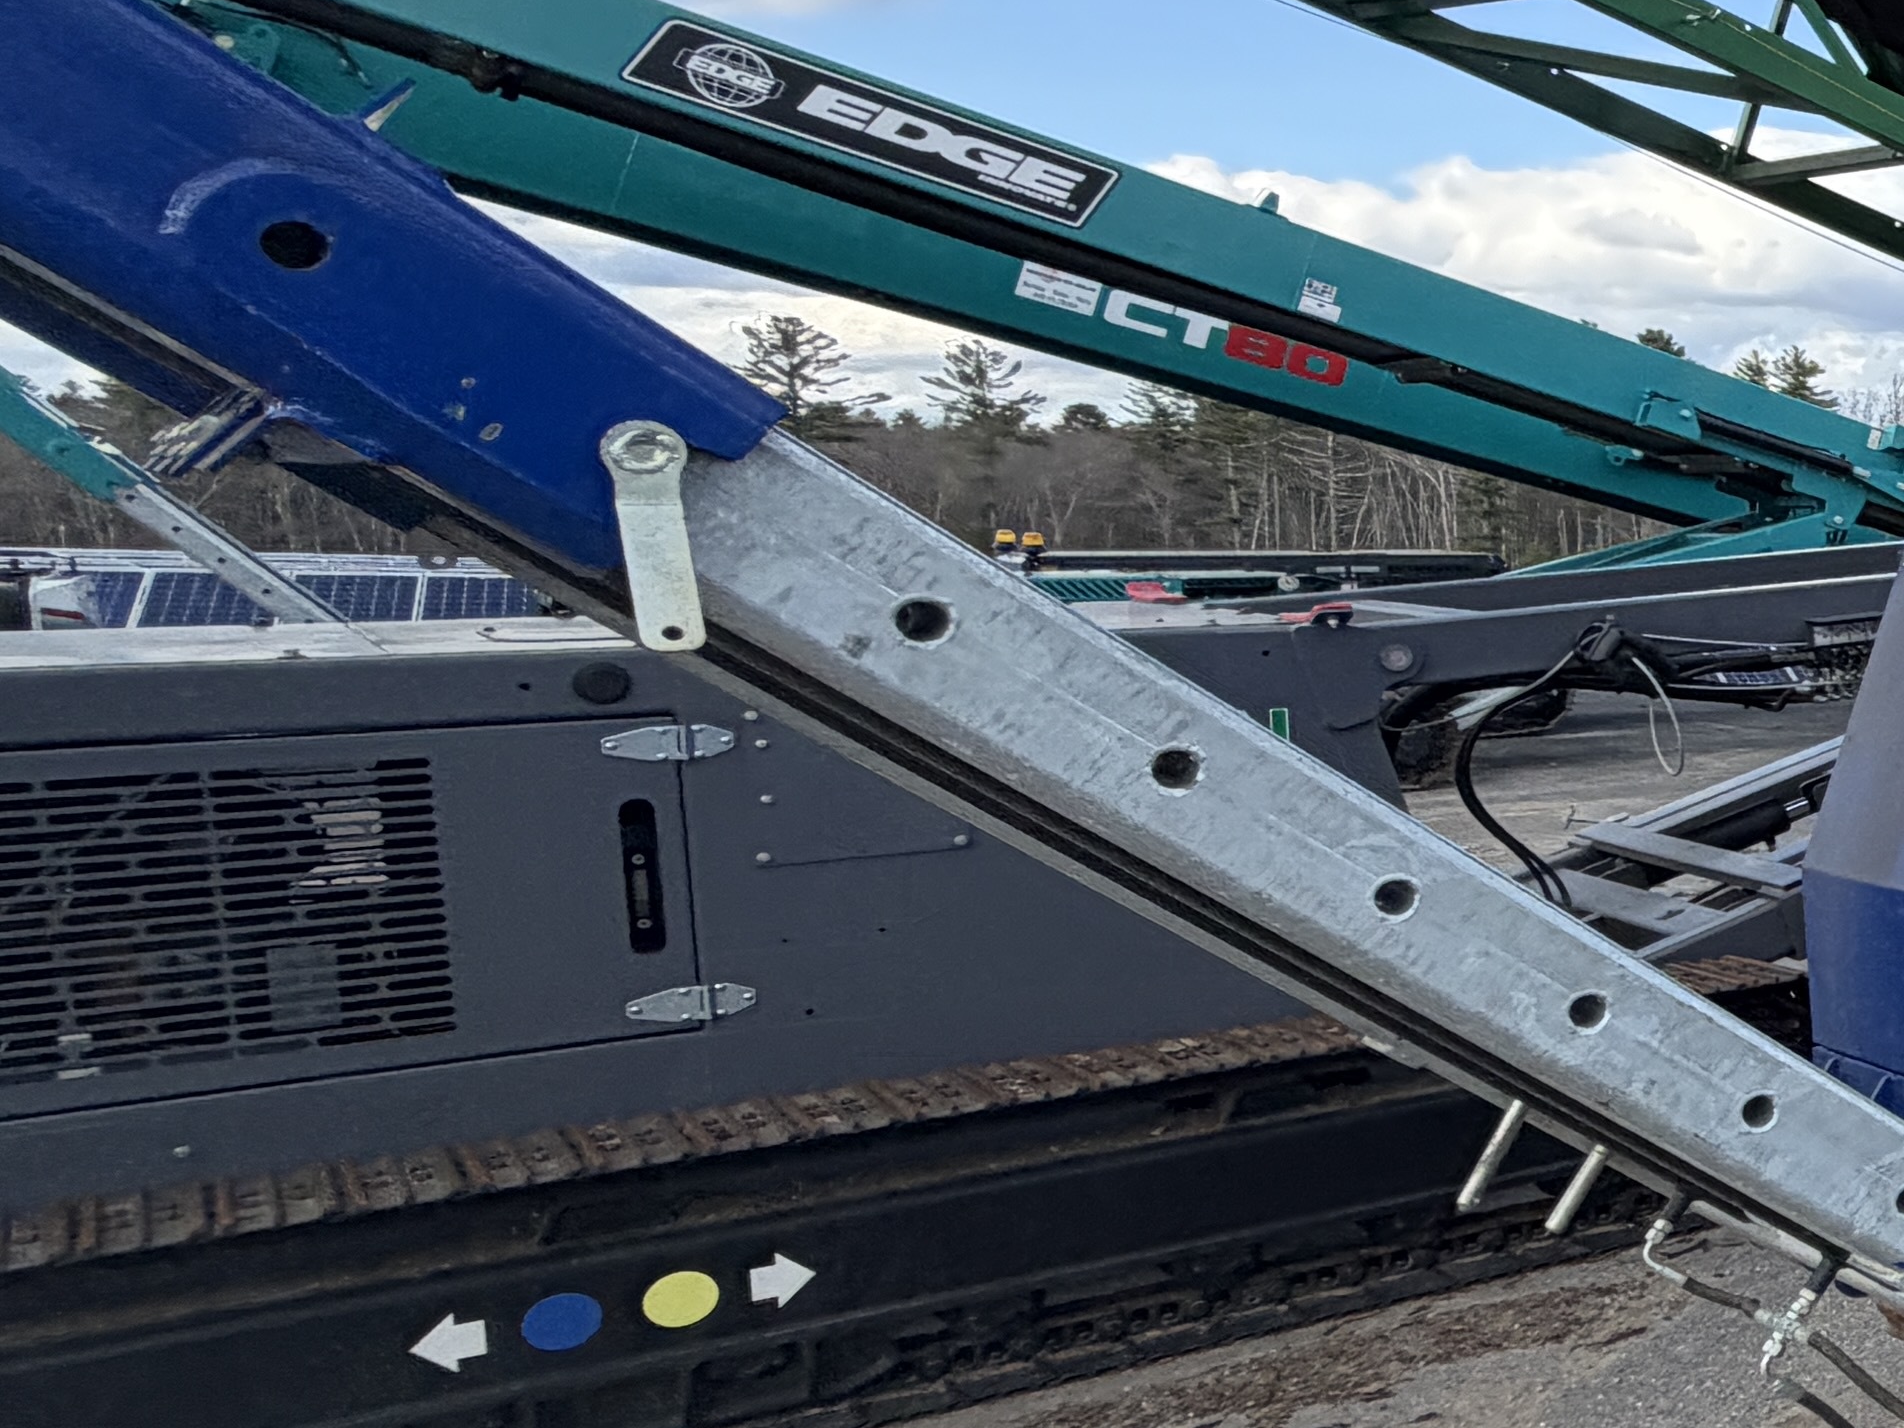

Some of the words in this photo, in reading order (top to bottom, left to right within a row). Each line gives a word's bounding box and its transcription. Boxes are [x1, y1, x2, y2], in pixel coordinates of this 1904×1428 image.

[686, 54, 777, 94] EDGE
[796, 83, 1087, 201] EDGE
[1104, 288, 1350, 388] CT80
